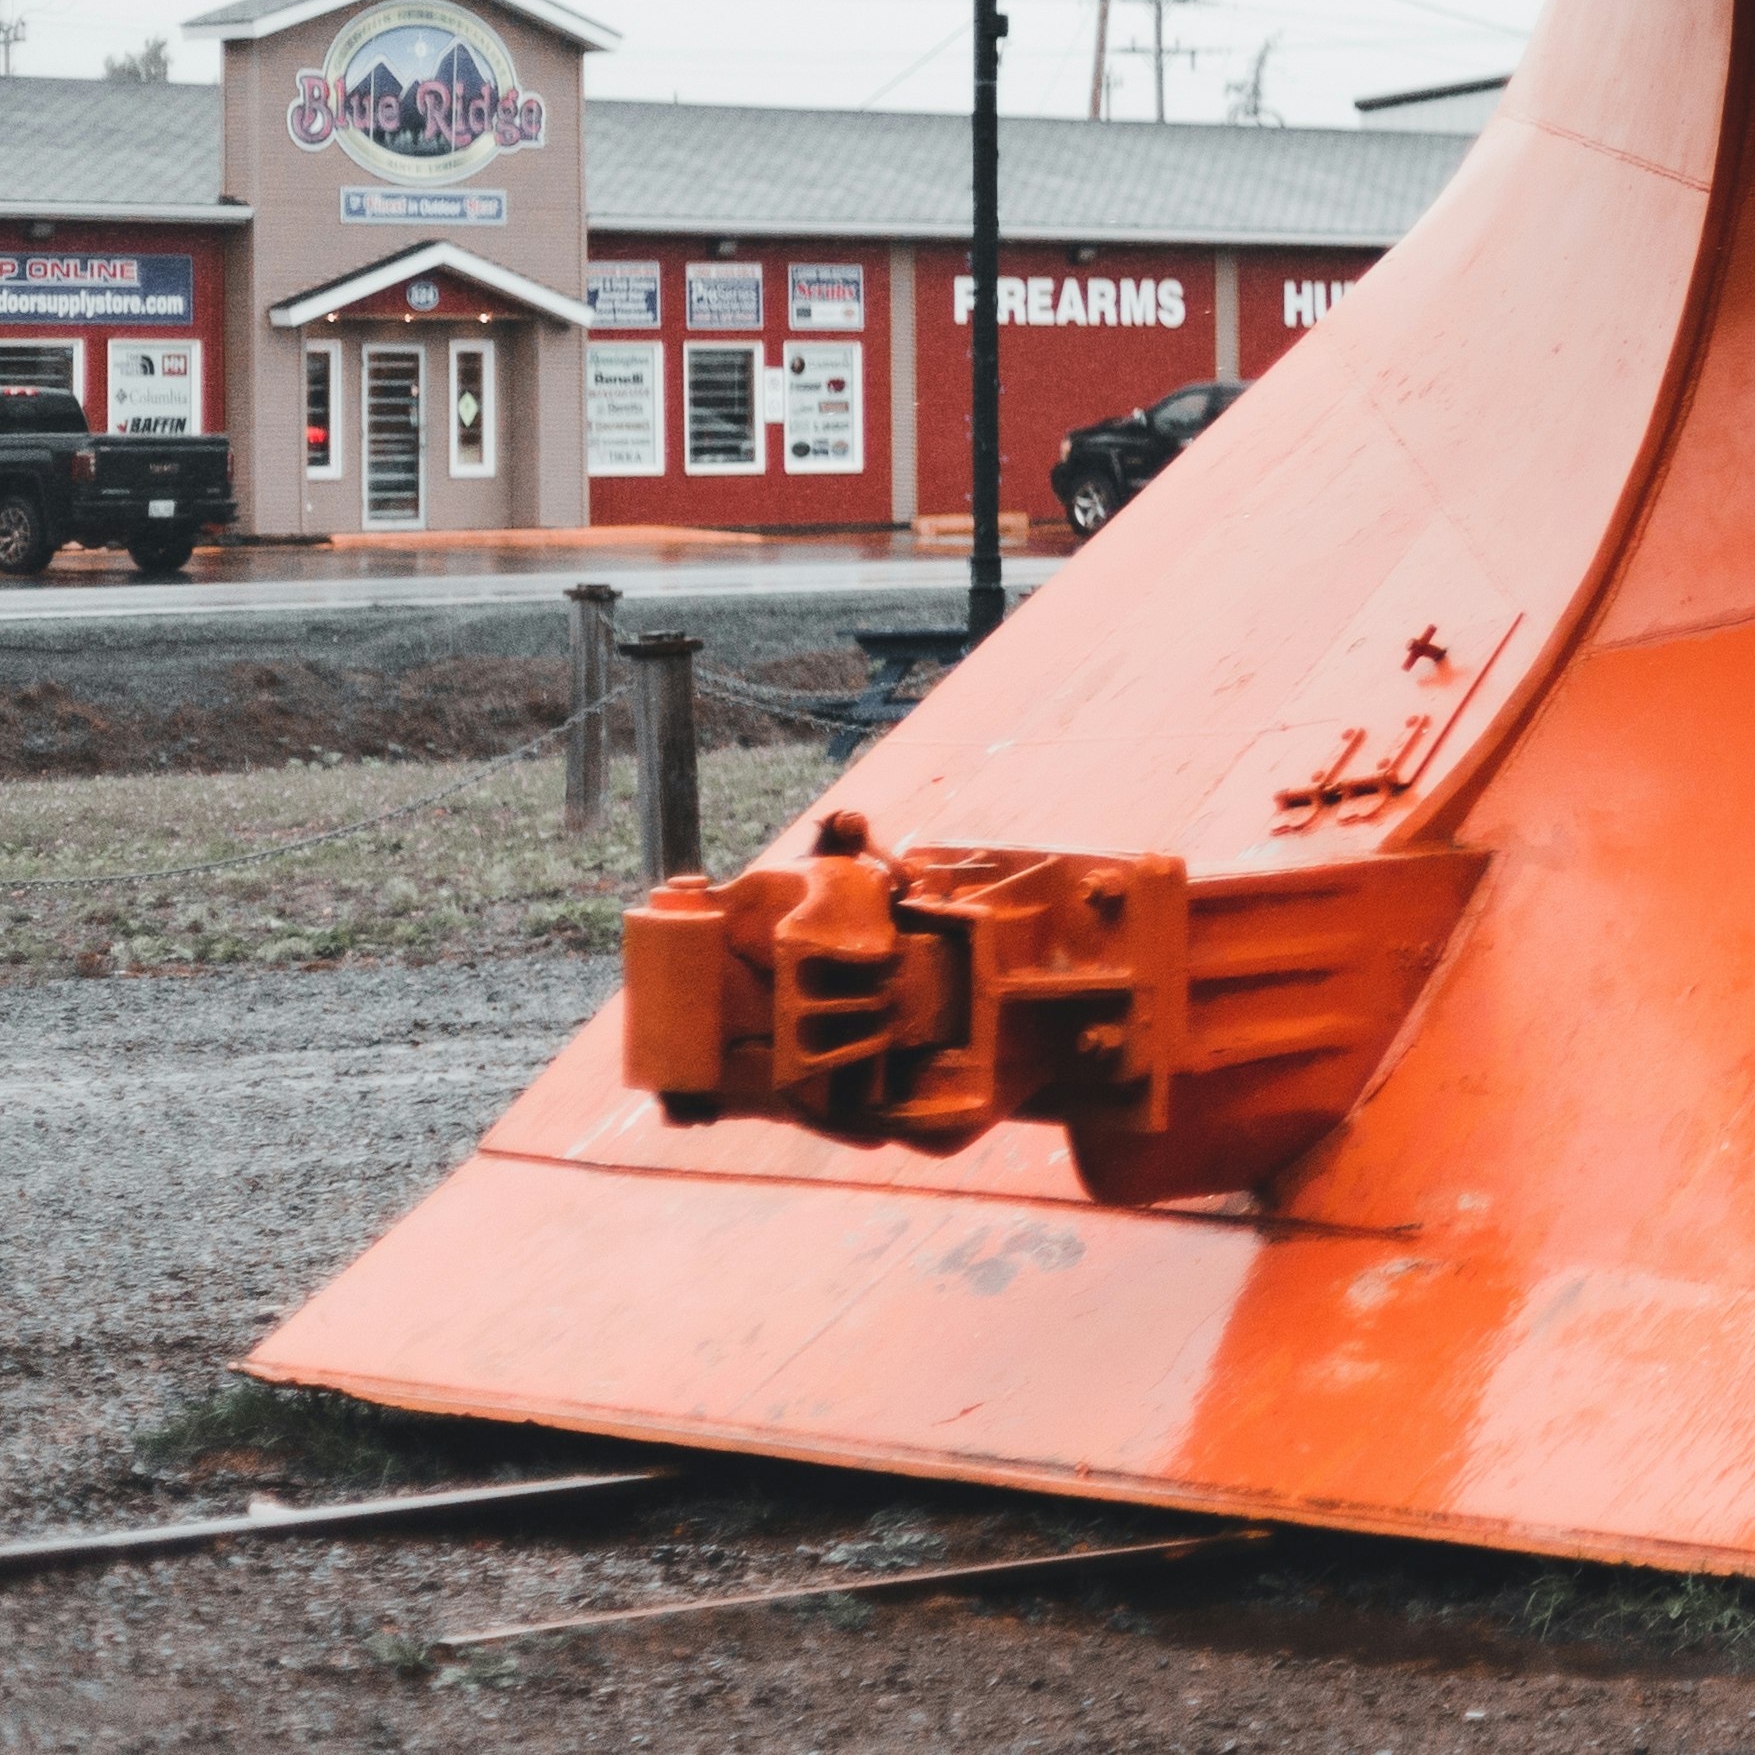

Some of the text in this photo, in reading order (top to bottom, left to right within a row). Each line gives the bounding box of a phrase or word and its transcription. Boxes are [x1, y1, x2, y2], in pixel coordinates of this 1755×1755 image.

[291, 75, 543, 149] Blue Ridge
[28, 260, 136, 281] ONLINE
[953, 275, 1185, 328] FREARMS
[1283, 279, 1354, 328] HU
[129, 387, 187, 406] Columbia
[130, 415, 187, 434] BAFFIN
